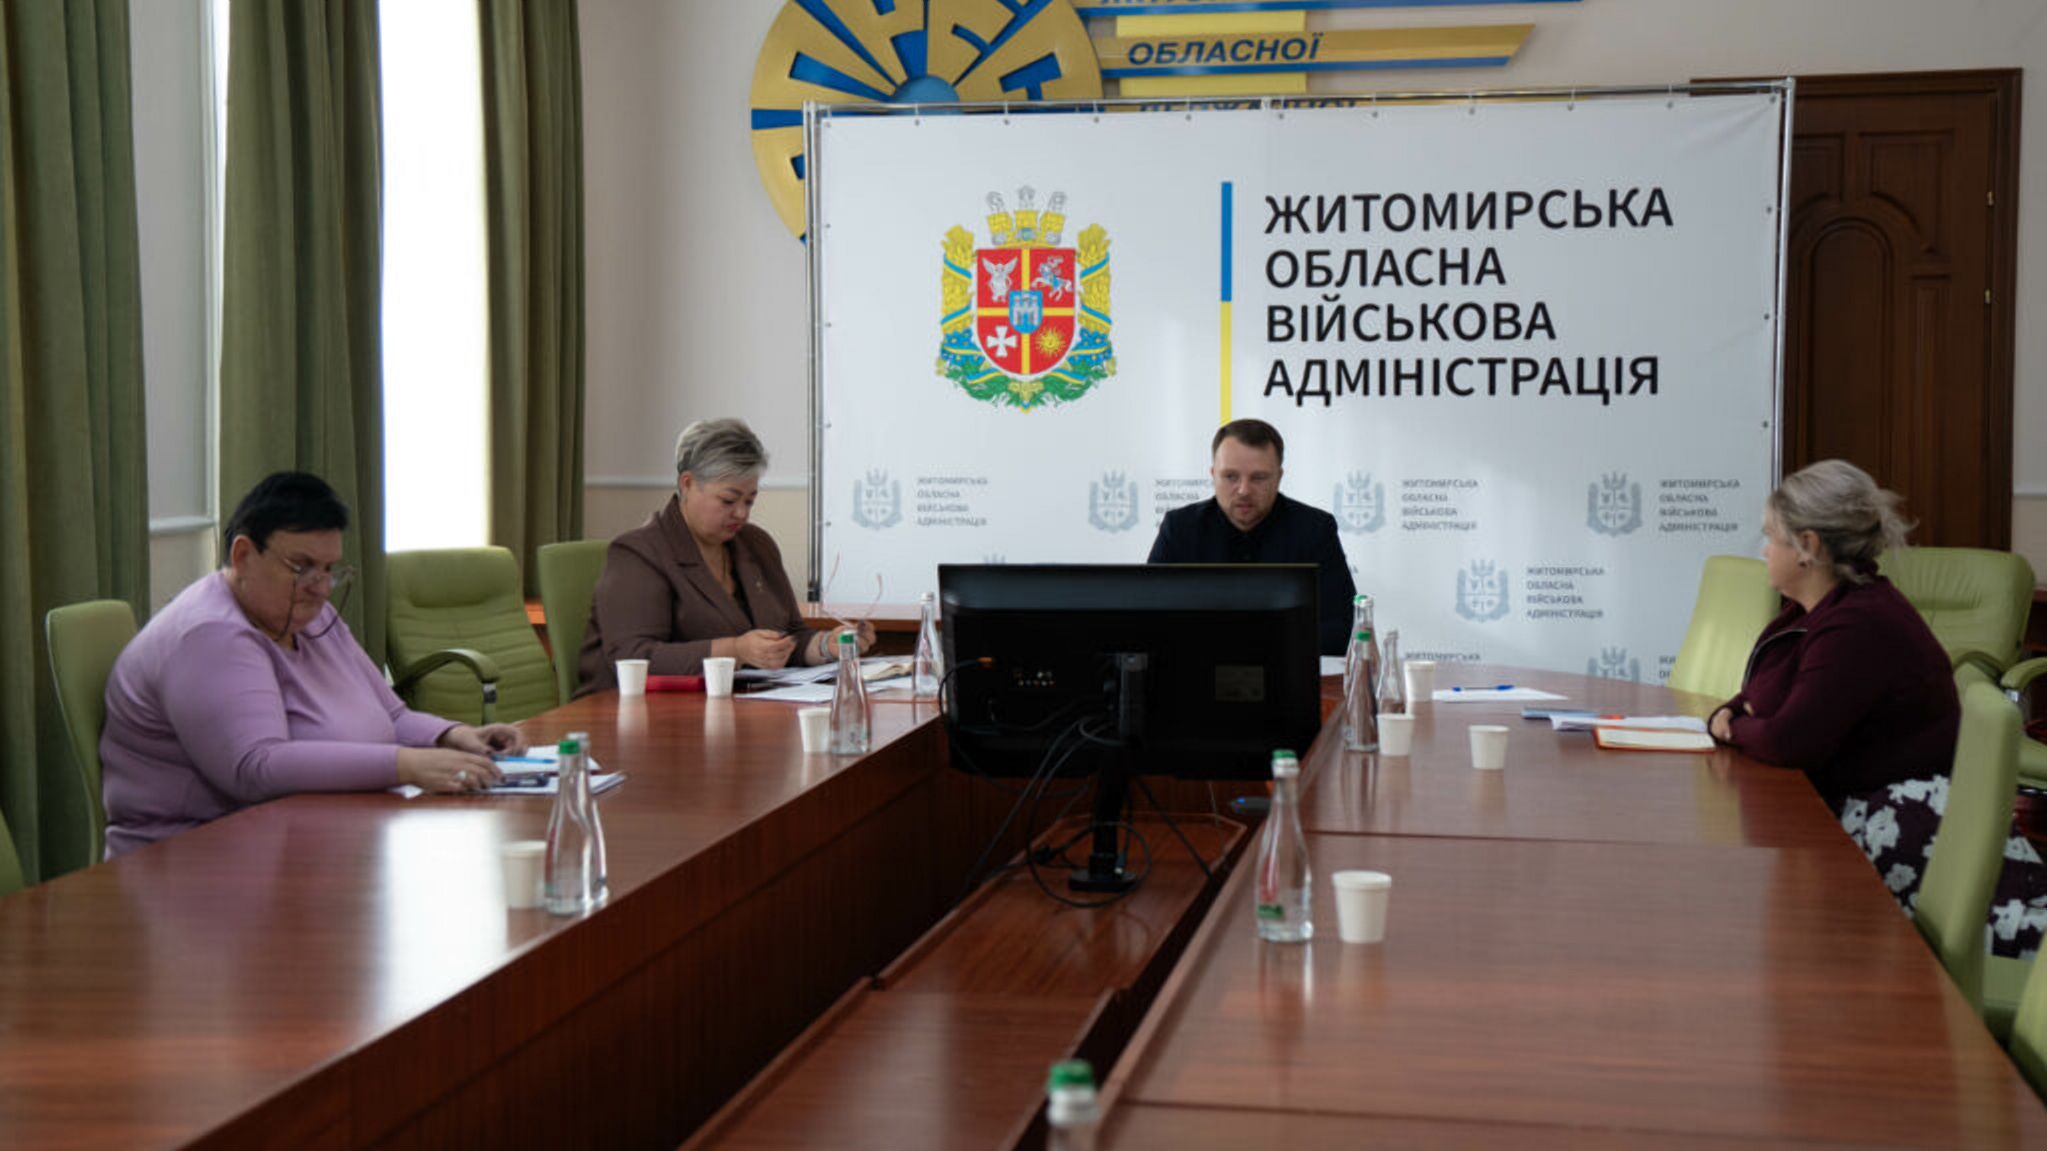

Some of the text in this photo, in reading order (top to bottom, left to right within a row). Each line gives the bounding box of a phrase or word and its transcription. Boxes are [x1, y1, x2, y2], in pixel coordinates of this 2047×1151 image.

[1128, 32, 1324, 65] ОБЛАСНОЇ
[1264, 187, 1674, 234] ЖИТОМИРСЬКА
[1265, 247, 1507, 288] ОБЛАСНА
[1267, 294, 1557, 342] ВІЙСЬКОВА
[1263, 356, 1659, 407] АДМІНІСТРАЦІЯ
